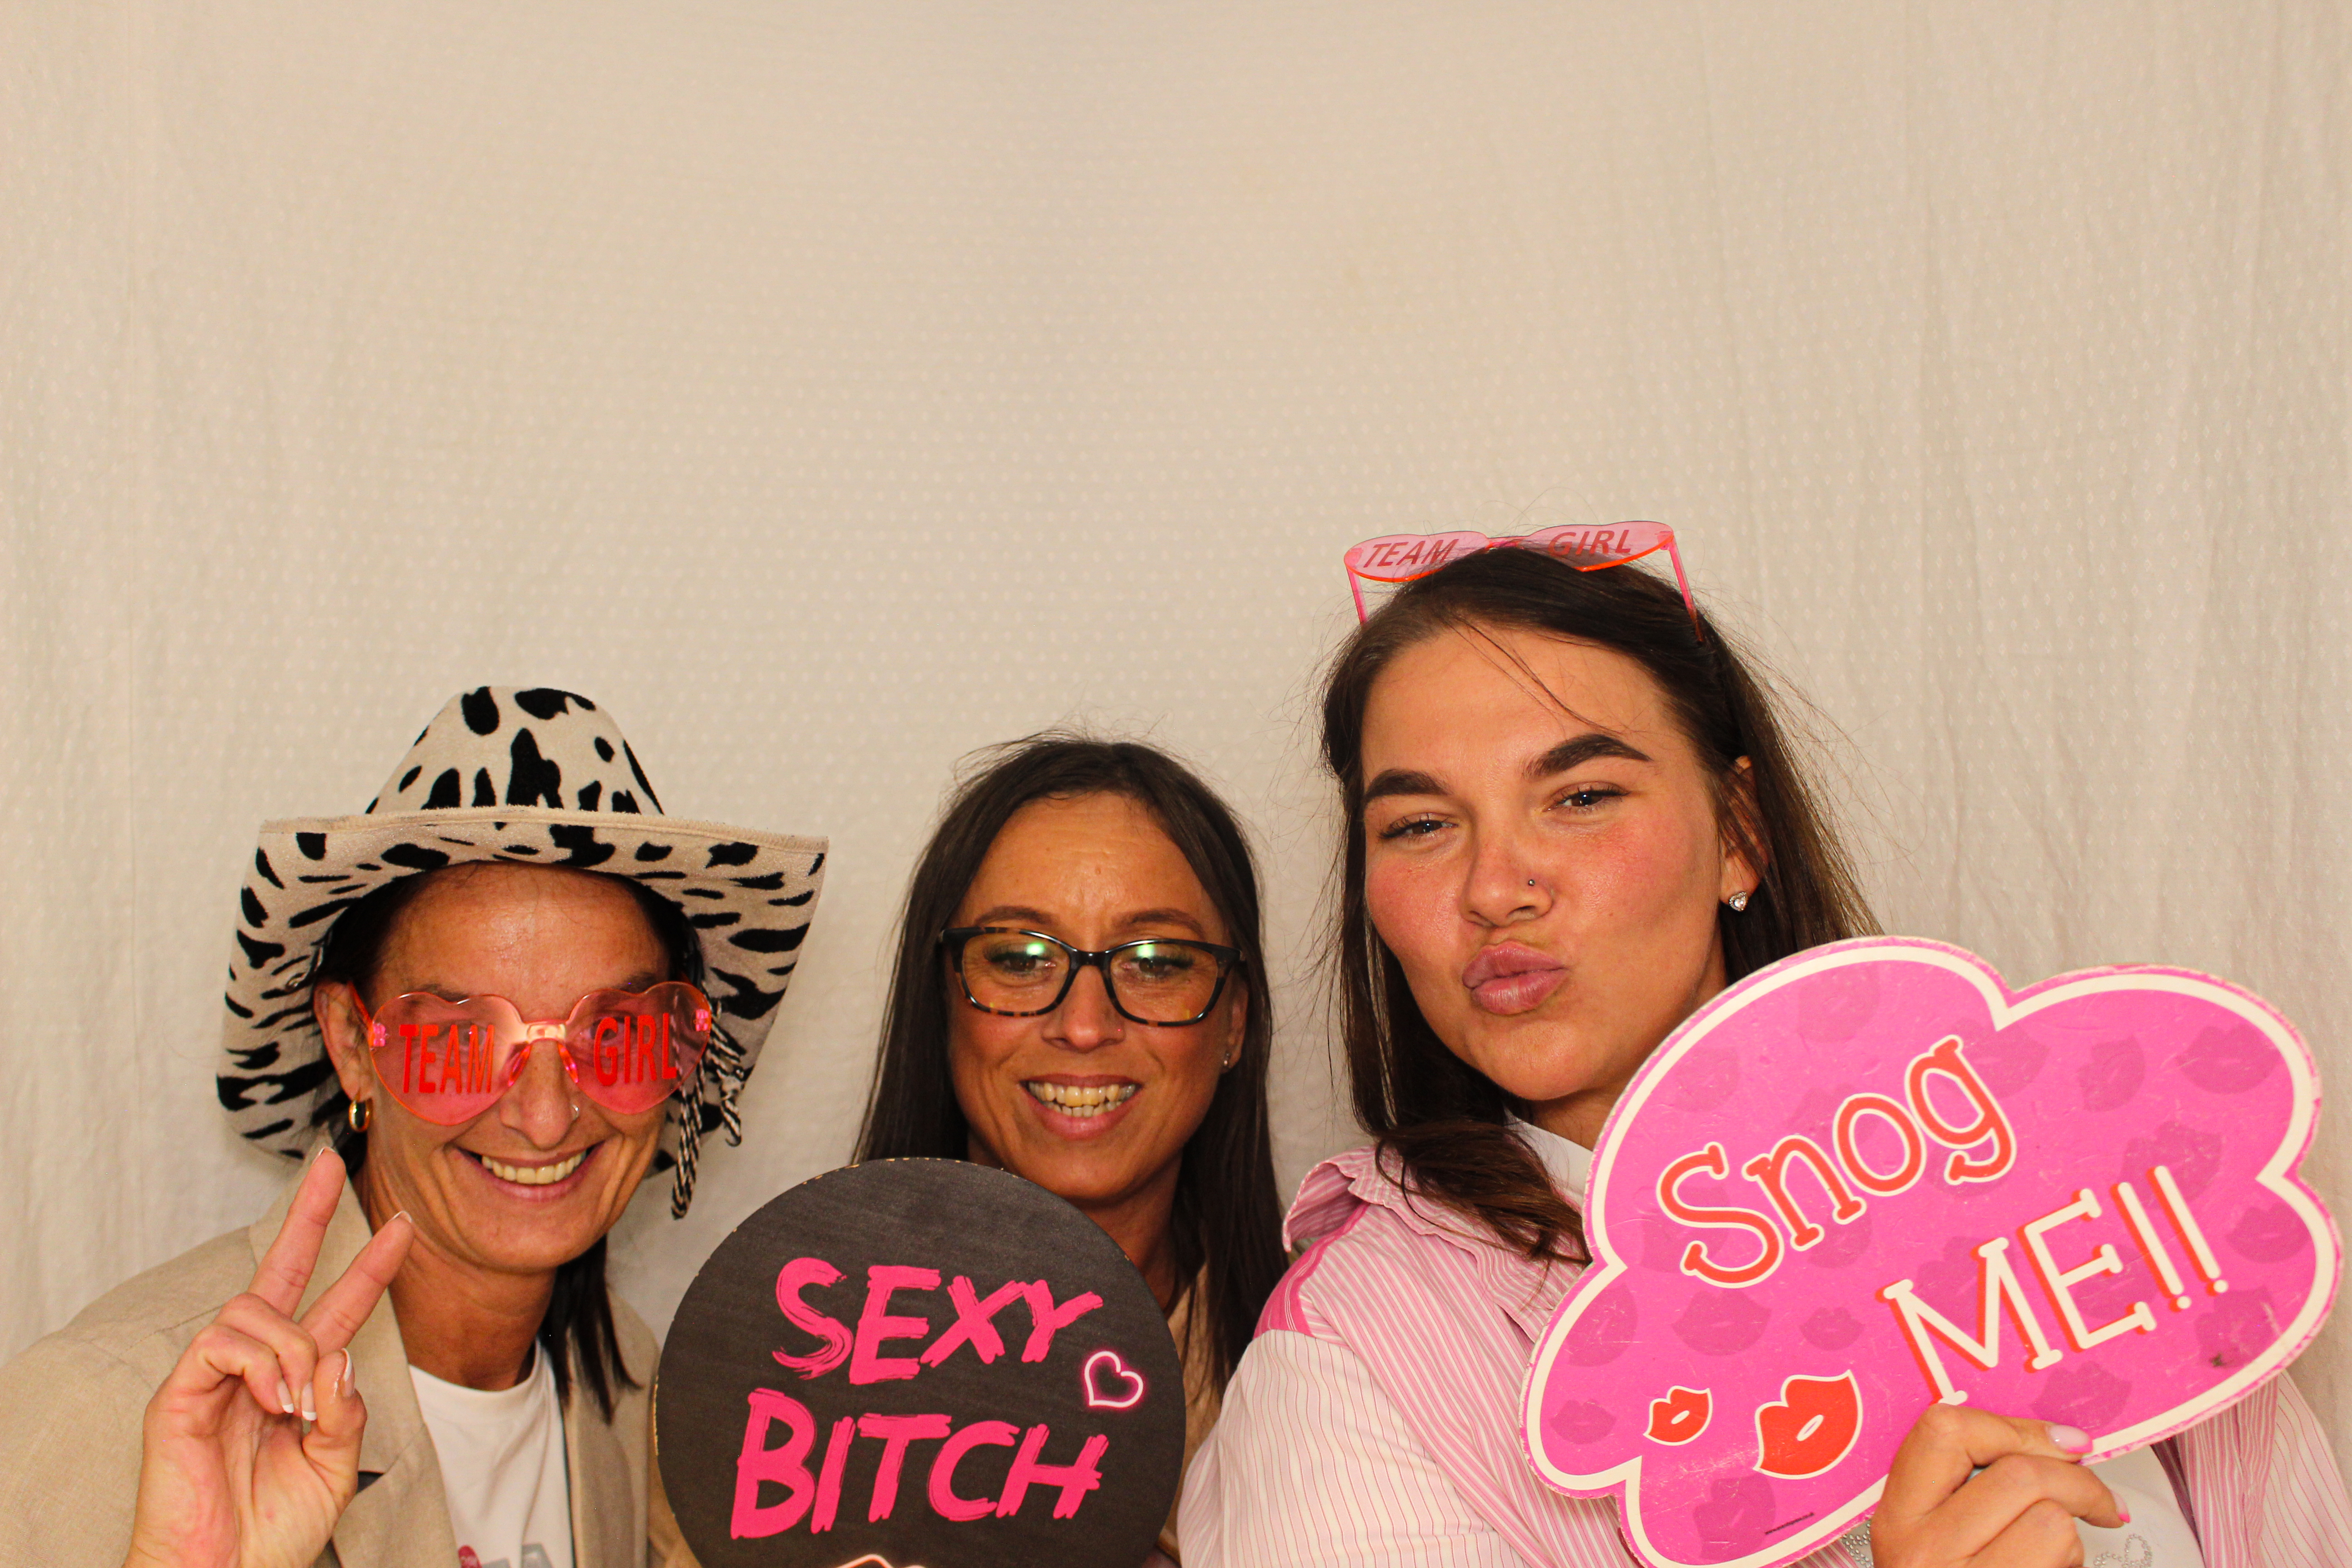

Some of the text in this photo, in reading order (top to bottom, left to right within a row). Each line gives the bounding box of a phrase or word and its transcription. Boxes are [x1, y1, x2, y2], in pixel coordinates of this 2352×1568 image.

[1363, 529, 1632, 568] TEAM GIRL
[399, 1012, 677, 1094] TEAM GIRL
[1656, 1034, 2017, 1289] Snog
[772, 1257, 1103, 1385] SEXY
[1875, 1165, 2229, 1405] ME!!
[730, 1387, 1109, 1539] BITCH
